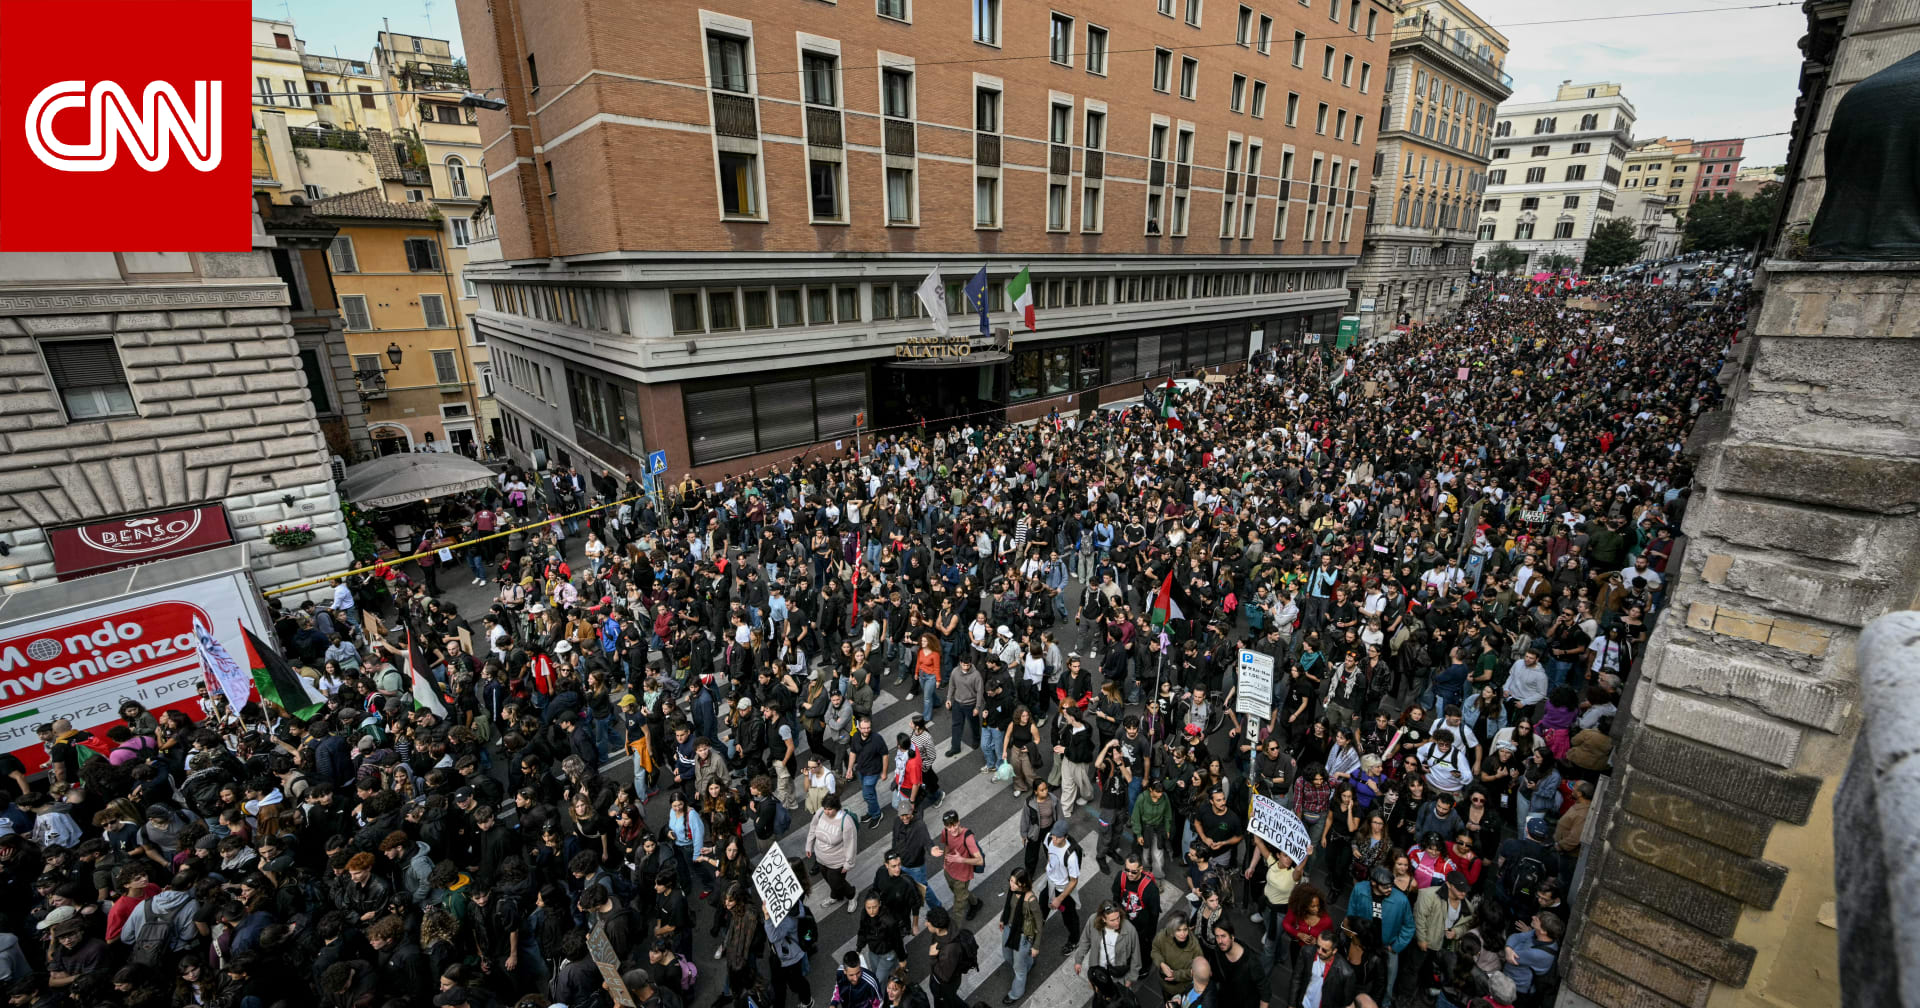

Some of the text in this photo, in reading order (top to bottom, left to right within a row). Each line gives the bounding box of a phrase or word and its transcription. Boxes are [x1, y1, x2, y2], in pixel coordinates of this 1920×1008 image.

[895, 344, 971, 358] PALATINO
[101, 519, 189, 544] BENSO
[138, 688, 149, 702] il
[155, 675, 201, 698] prez
[1251, 818, 1306, 861] CERTO PUNTO
[1254, 808, 1267, 822] MA
[1268, 816, 1287, 834] FINO
[1297, 837, 1309, 848] UN
[761, 857, 792, 911] LO POSSO
[769, 849, 799, 894] NON ME
